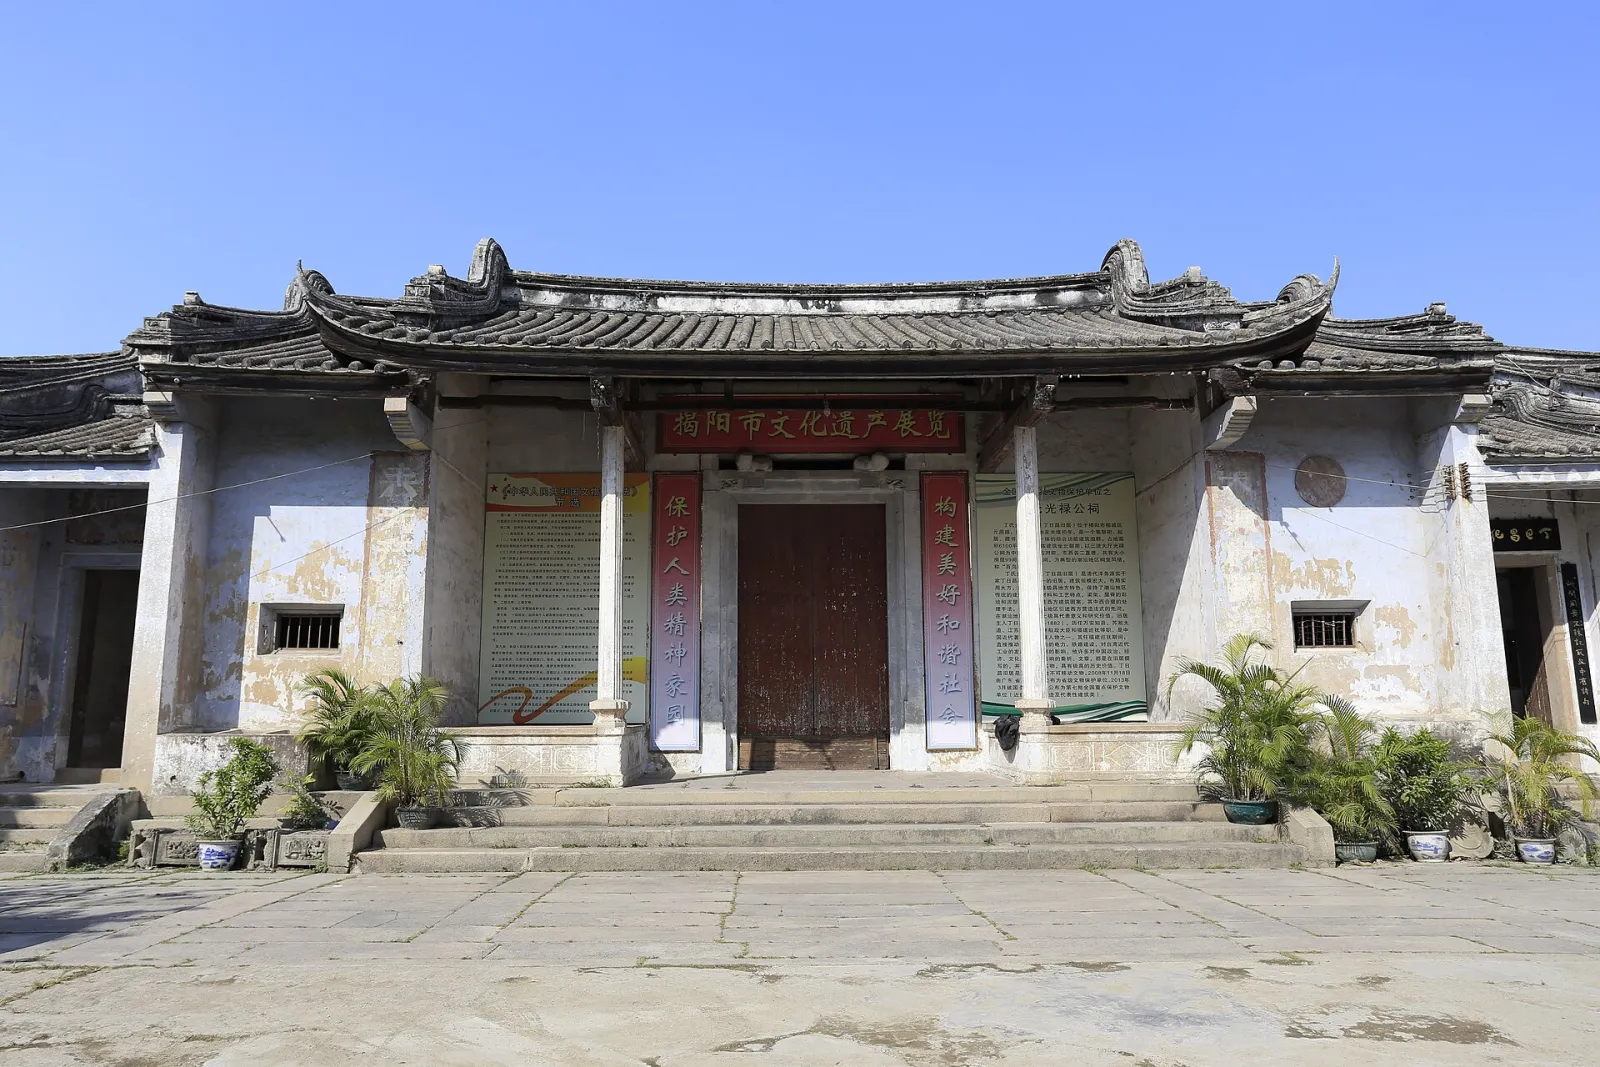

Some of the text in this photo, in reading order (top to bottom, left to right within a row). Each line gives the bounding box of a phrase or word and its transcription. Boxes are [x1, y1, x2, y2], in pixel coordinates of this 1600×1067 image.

[501, 485, 638, 497] 《中华人民共和国文物法》
[672, 409, 951, 441] 揭阳市文化遗产展览
[663, 494, 691, 726] 保护人类精神家园
[934, 494, 964, 726] 构建美好和谐社会
